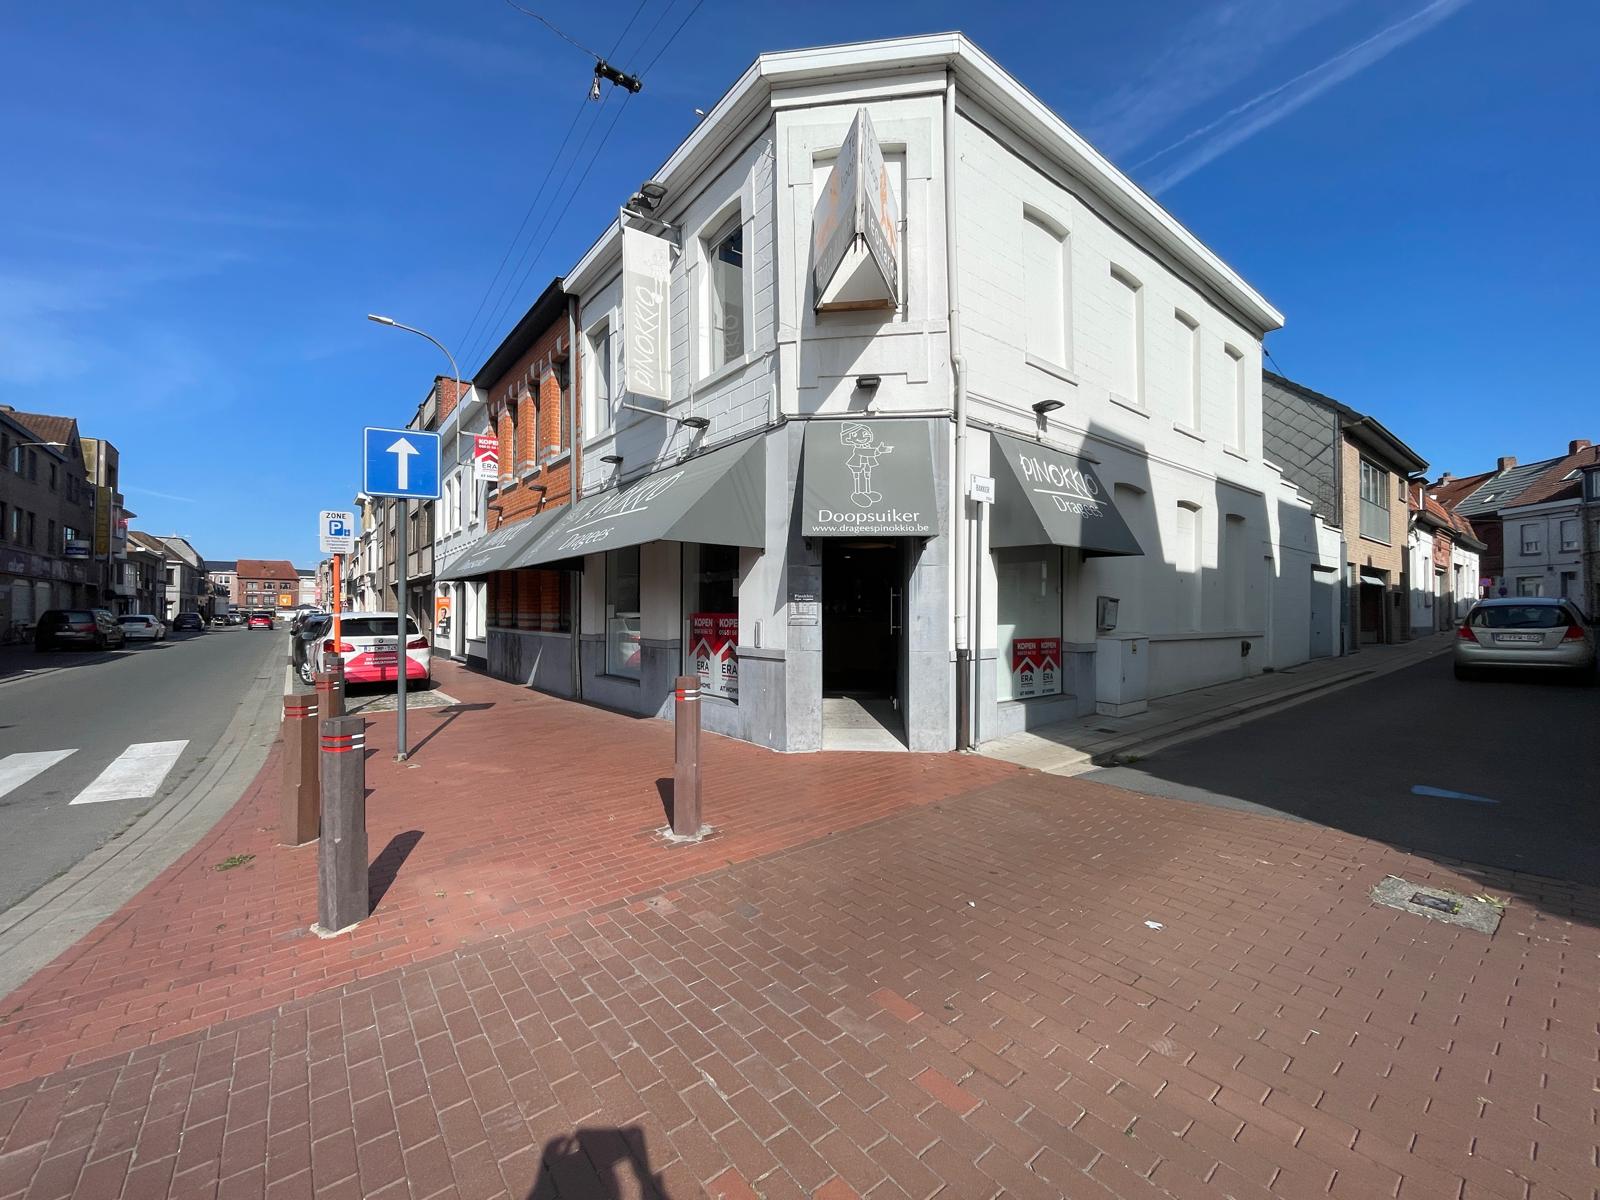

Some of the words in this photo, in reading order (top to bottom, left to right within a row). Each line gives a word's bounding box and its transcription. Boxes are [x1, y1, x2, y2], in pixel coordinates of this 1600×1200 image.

[634, 286, 658, 391] PINOKKIO
[482, 462, 497, 470] ERA
[1019, 454, 1099, 498] PINOKKIO
[1052, 495, 1104, 518] Dragees
[818, 508, 920, 525] Doopsuiker
[812, 524, 929, 534] www.drageespinokkio.be
[694, 618, 714, 627] KOPEN
[719, 618, 738, 628] KOPE
[696, 661, 710, 672] ERA
[722, 664, 738, 674] ERA
[1020, 674, 1034, 682] ERA
[1042, 672, 1054, 680] ERA
